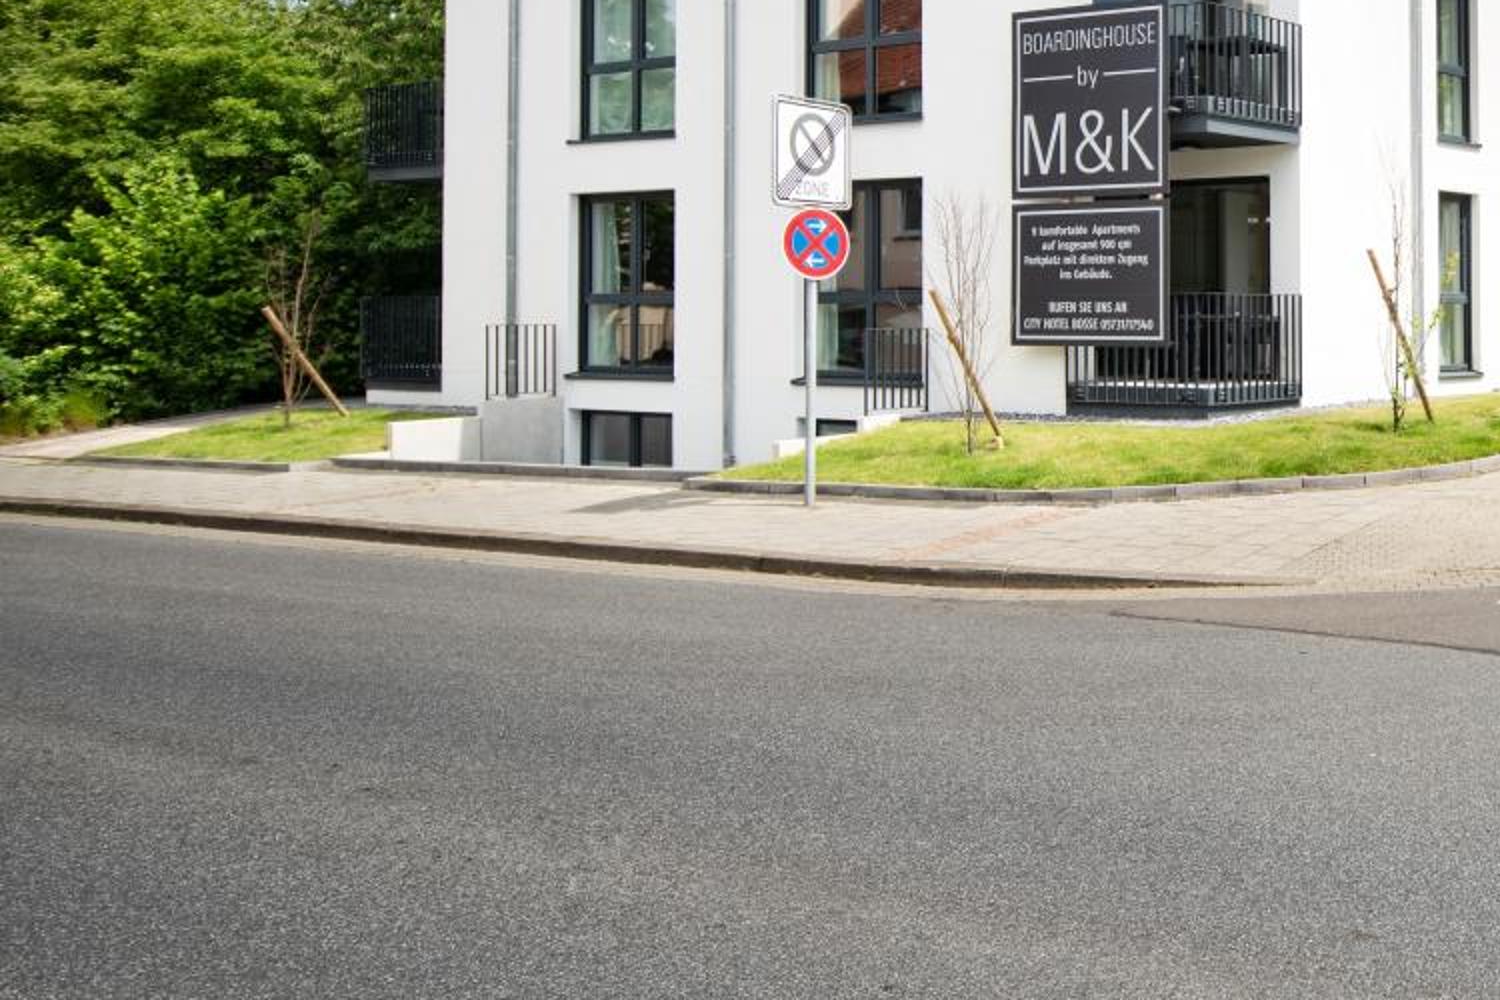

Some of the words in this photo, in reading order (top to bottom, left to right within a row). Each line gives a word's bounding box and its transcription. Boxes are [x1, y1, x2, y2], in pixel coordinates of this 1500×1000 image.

[1023, 21, 1156, 55] BOARDINGHOUSE
[1077, 65, 1099, 89] by
[1023, 106, 1155, 177] M&K
[1039, 224, 1088, 237] fortable
[1091, 224, 1141, 237] Apart
[1023, 255, 1061, 268] Pplatz
[1048, 301, 1077, 313] FEN
[1078, 301, 1093, 313] SIE
[1114, 301, 1128, 313] A
